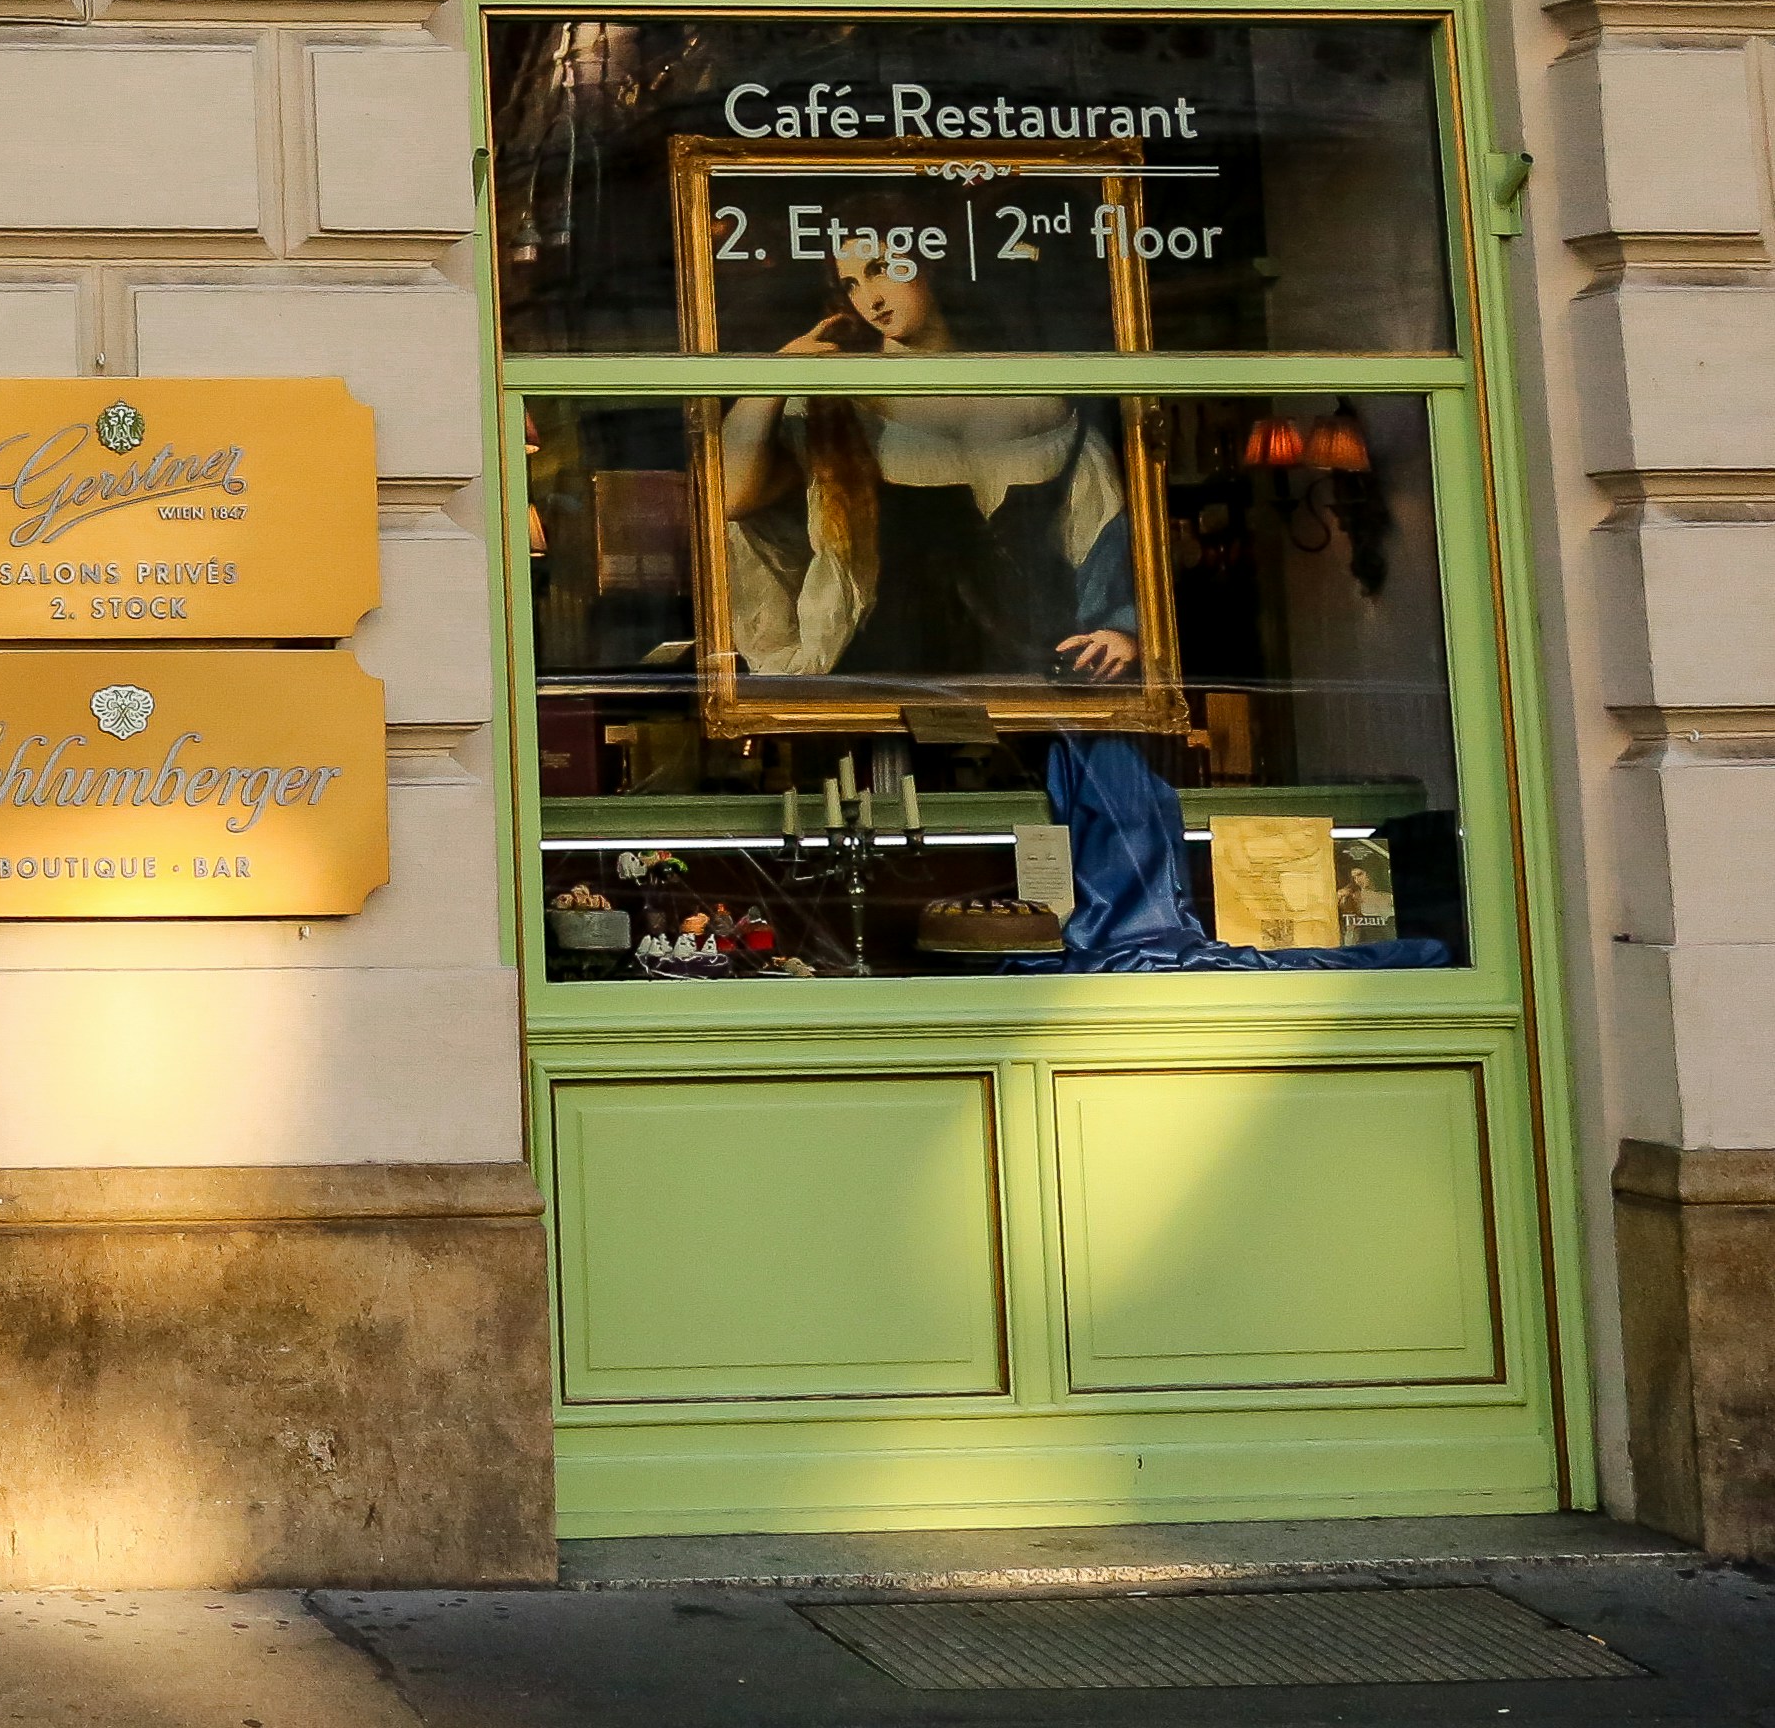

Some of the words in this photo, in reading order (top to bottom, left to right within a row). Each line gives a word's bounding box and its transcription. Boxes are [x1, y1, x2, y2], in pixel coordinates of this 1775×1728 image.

[724, 82, 1196, 139] Café-Restaurant
[715, 206, 767, 260] 2.
[790, 205, 948, 283] Etage
[997, 202, 1071, 261] 2nd
[1091, 202, 1223, 261] floor
[158, 505, 205, 521] WIEN
[210, 504, 249, 521] 1847
[136, 556, 239, 585] PRIVÉS
[51, 597, 76, 620] 2.
[91, 596, 188, 620] STOCK
[194, 858, 252, 879] BAR
